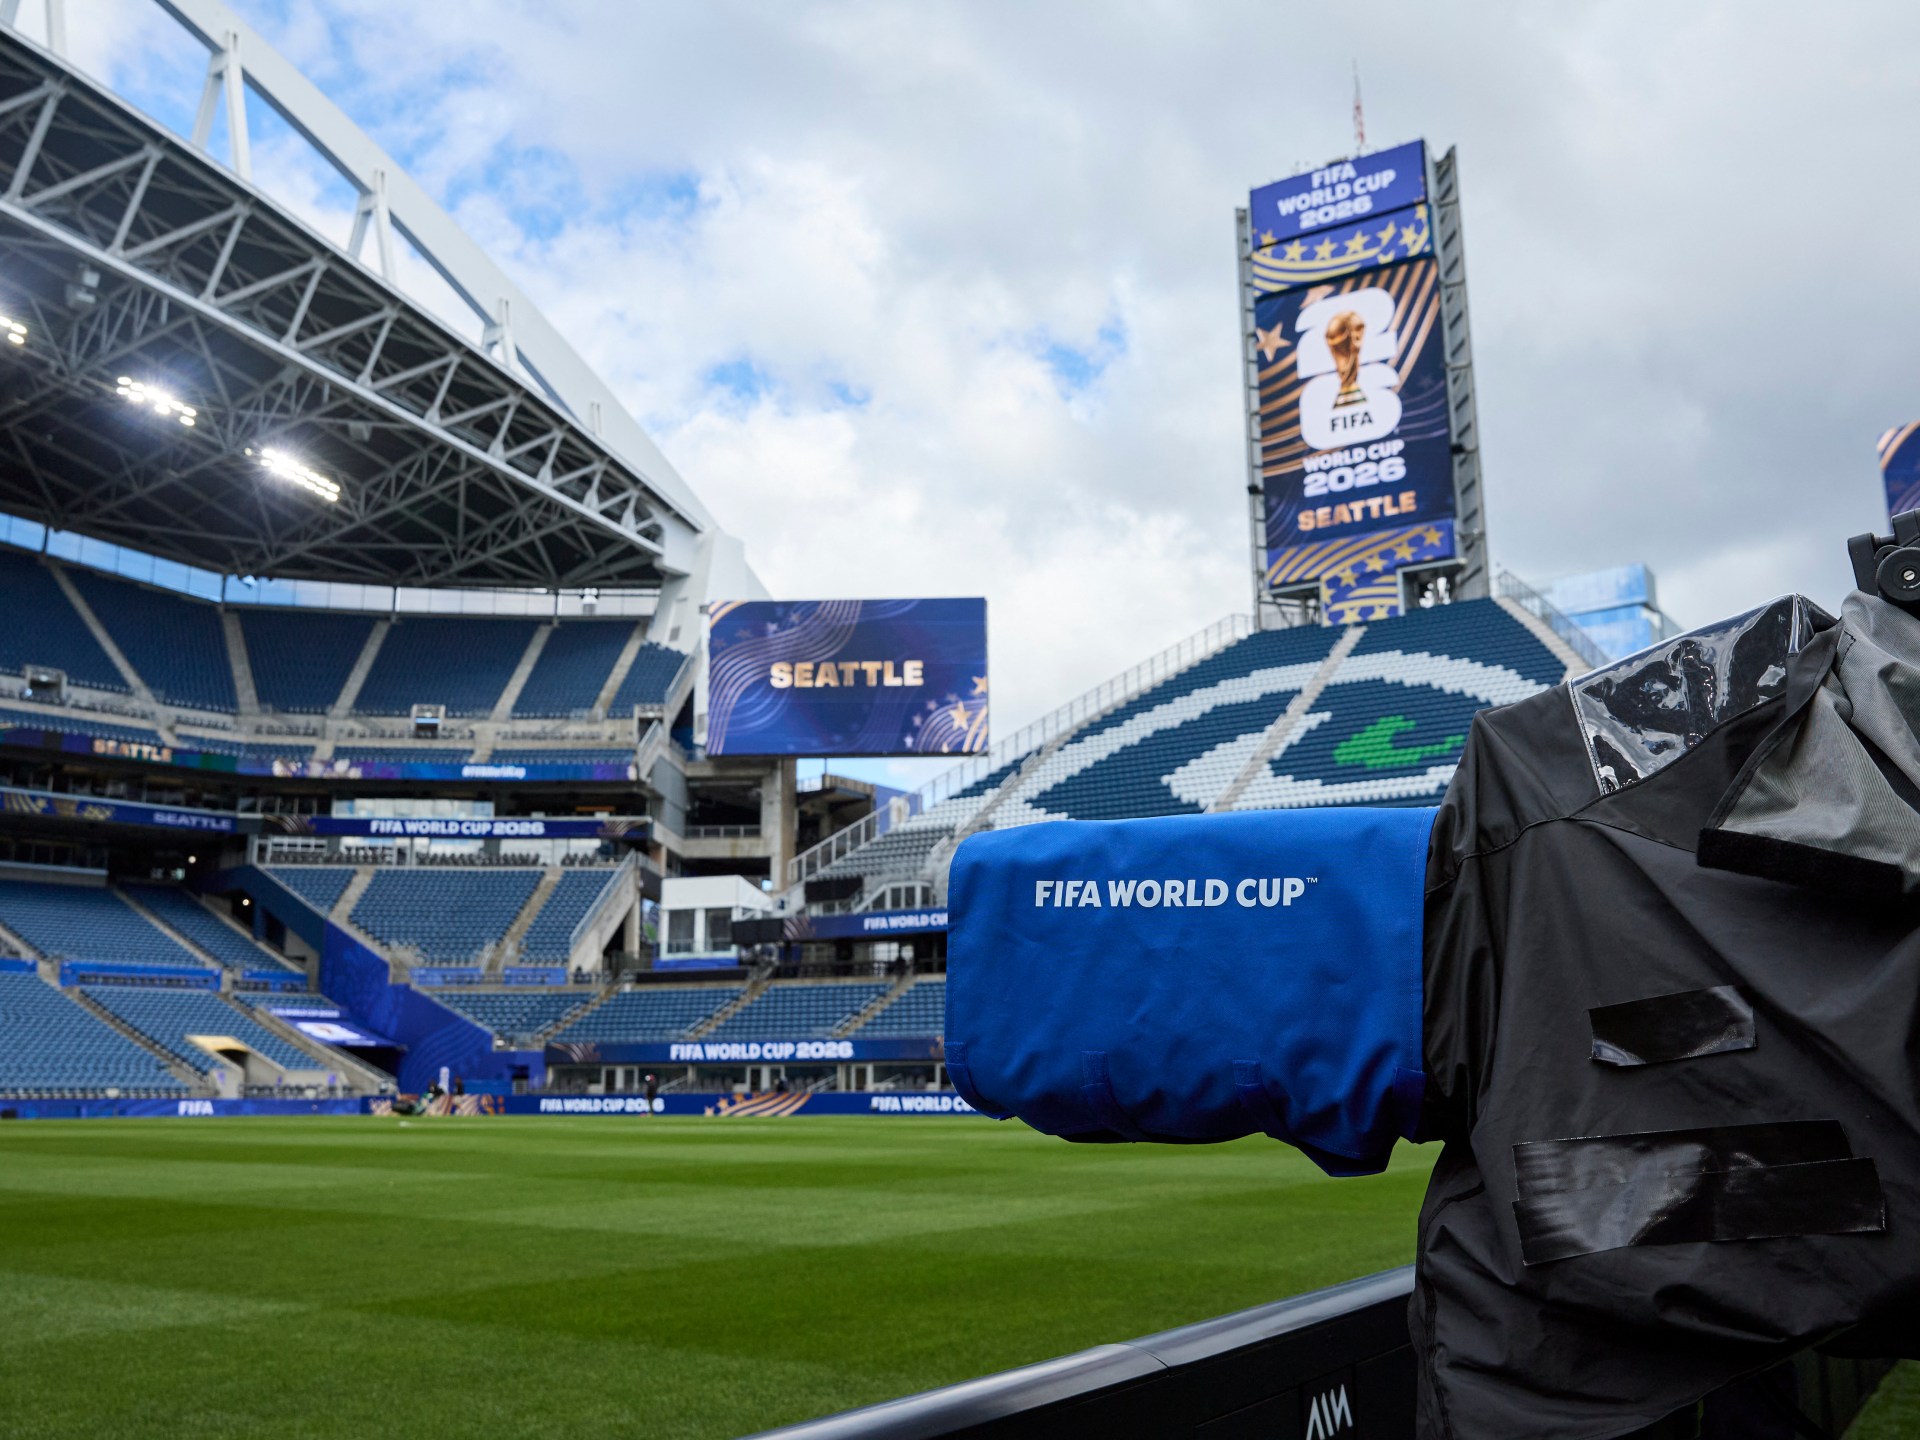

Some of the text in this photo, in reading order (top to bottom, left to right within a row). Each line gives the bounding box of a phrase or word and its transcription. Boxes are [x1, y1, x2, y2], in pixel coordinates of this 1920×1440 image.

[1311, 162, 1357, 189] FIFA
[1277, 169, 1397, 217] WORLD CUP
[1299, 195, 1373, 229] 2026
[1331, 411, 1373, 432] FIFA
[1303, 439, 1405, 473] WORLD CUP
[1303, 456, 1407, 498] 2026
[1298, 490, 1417, 531] SEATTLE
[769, 659, 924, 689] SEATTLE
[93, 738, 172, 763] SEATTLE
[153, 811, 232, 831] SEATTLE
[370, 820, 545, 836] FIFA WORLD CUP 2026
[1035, 880, 1101, 907] FIFA
[1107, 878, 1228, 907] WORLD
[863, 912, 948, 931] FIFA WORLD CU
[670, 1040, 854, 1061] FIFA WORLD CUP 2026
[178, 1100, 214, 1116] FIFA
[540, 1098, 564, 1112] FIFA
[563, 1098, 602, 1112] WORLD
[602, 1098, 625, 1112] CUP
[871, 1096, 901, 1112] FIFA
[901, 1096, 952, 1112] WORLD
